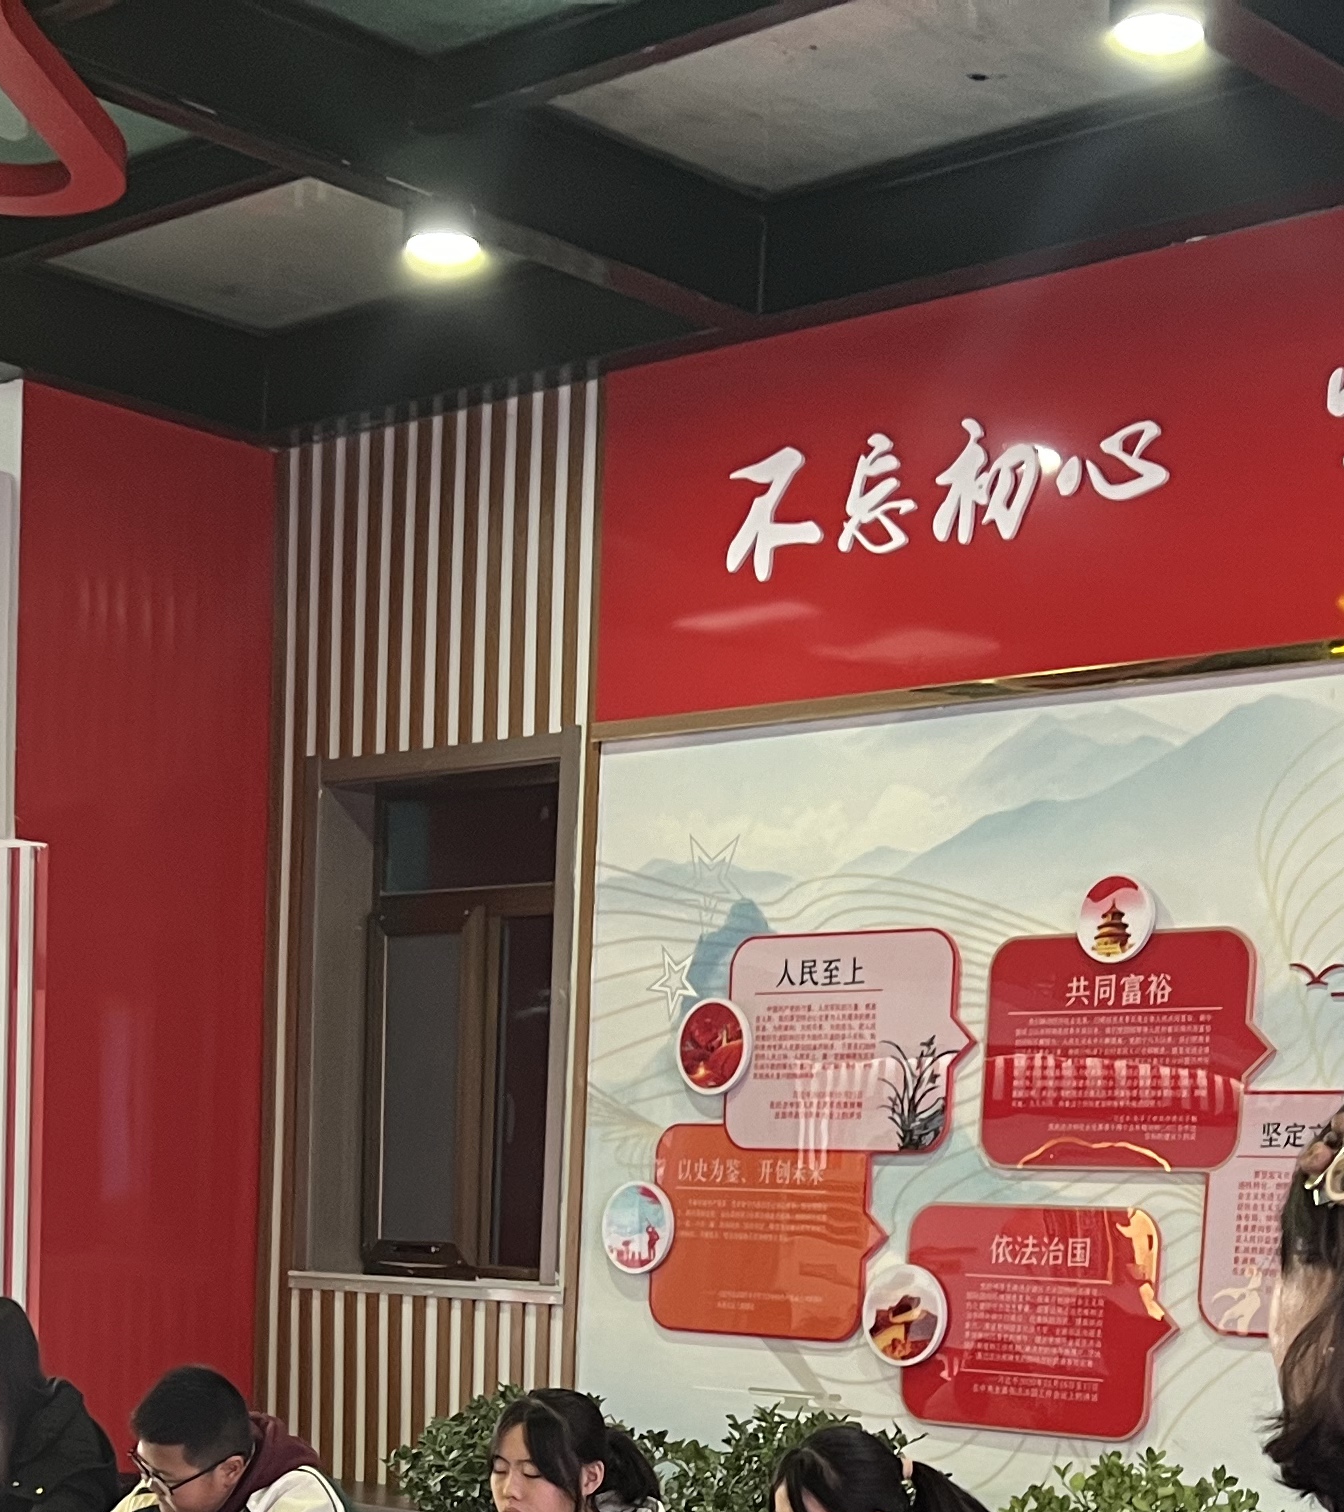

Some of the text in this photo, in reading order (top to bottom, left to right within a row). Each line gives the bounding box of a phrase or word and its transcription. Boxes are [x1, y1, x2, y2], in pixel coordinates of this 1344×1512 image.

[726, 419, 1170, 583] 不忘初心
[774, 957, 866, 989] 人民至上
[1065, 972, 1174, 1008] 共同富裕
[989, 1233, 1092, 1269] 依法治国
